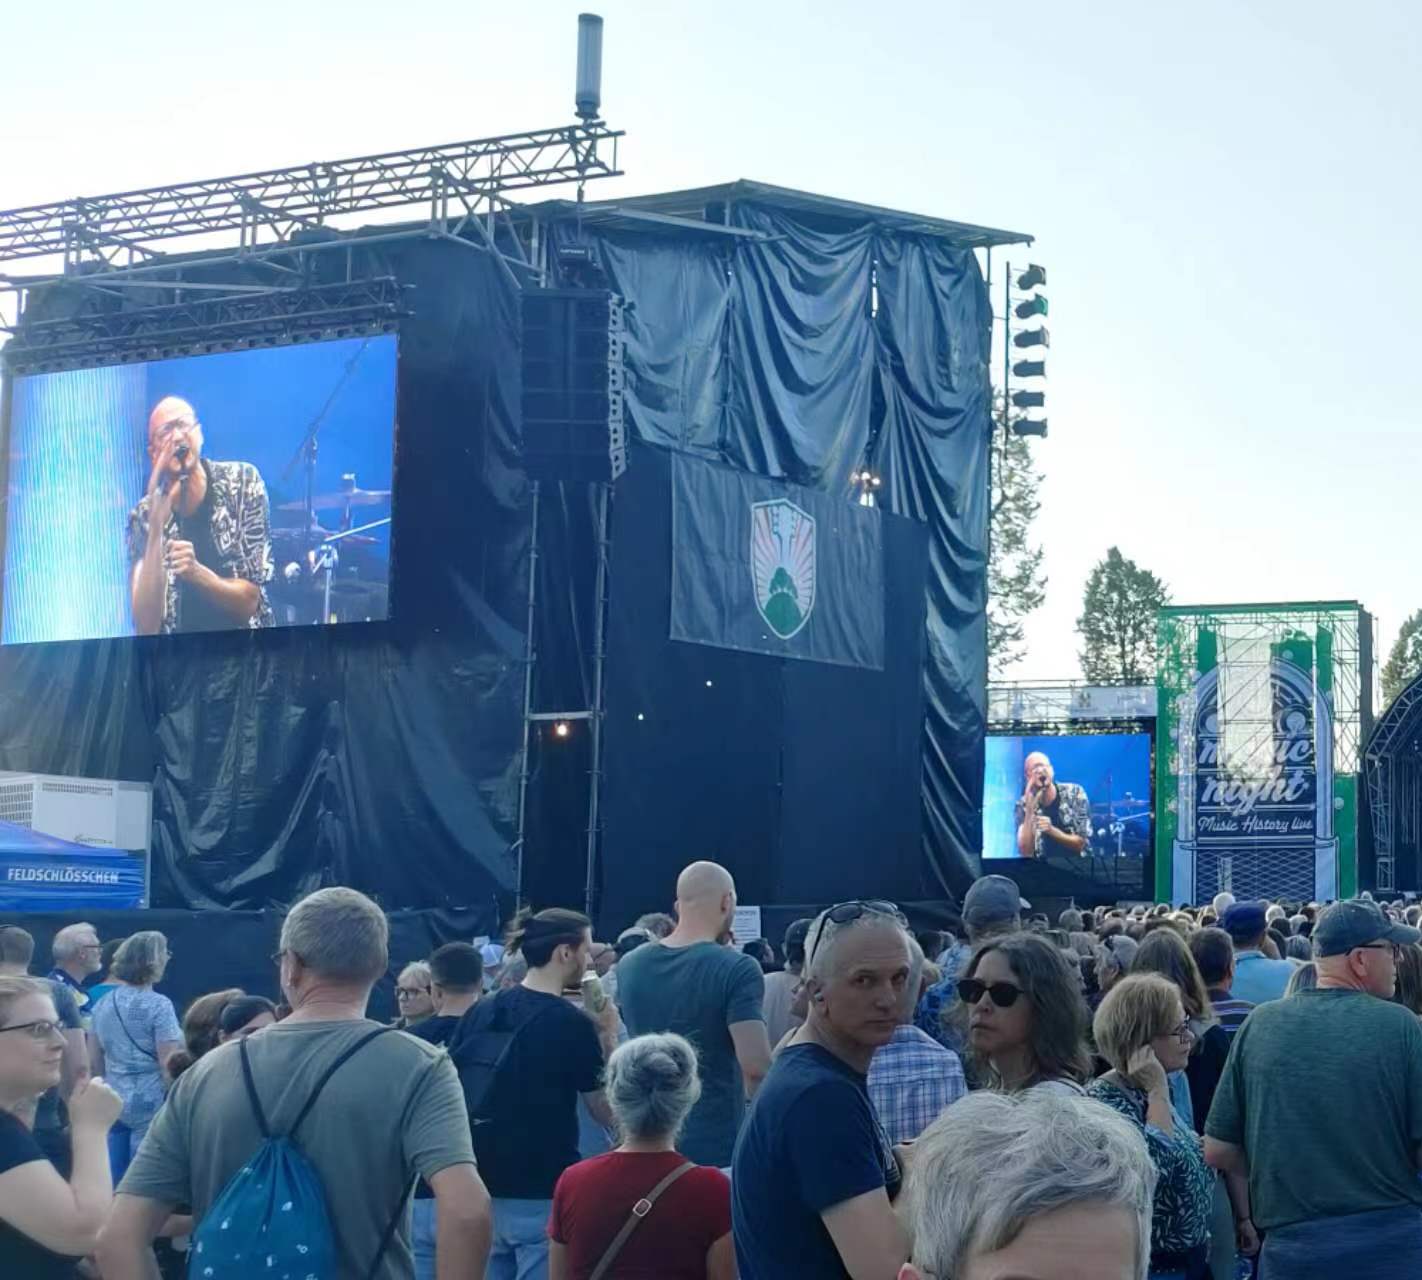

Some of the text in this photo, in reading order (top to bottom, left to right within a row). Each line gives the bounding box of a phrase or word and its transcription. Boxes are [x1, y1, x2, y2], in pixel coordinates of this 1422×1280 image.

[1197, 814, 1314, 834] Music History live
[7, 866, 120, 884] FELDSCHLÖSSCHEN
